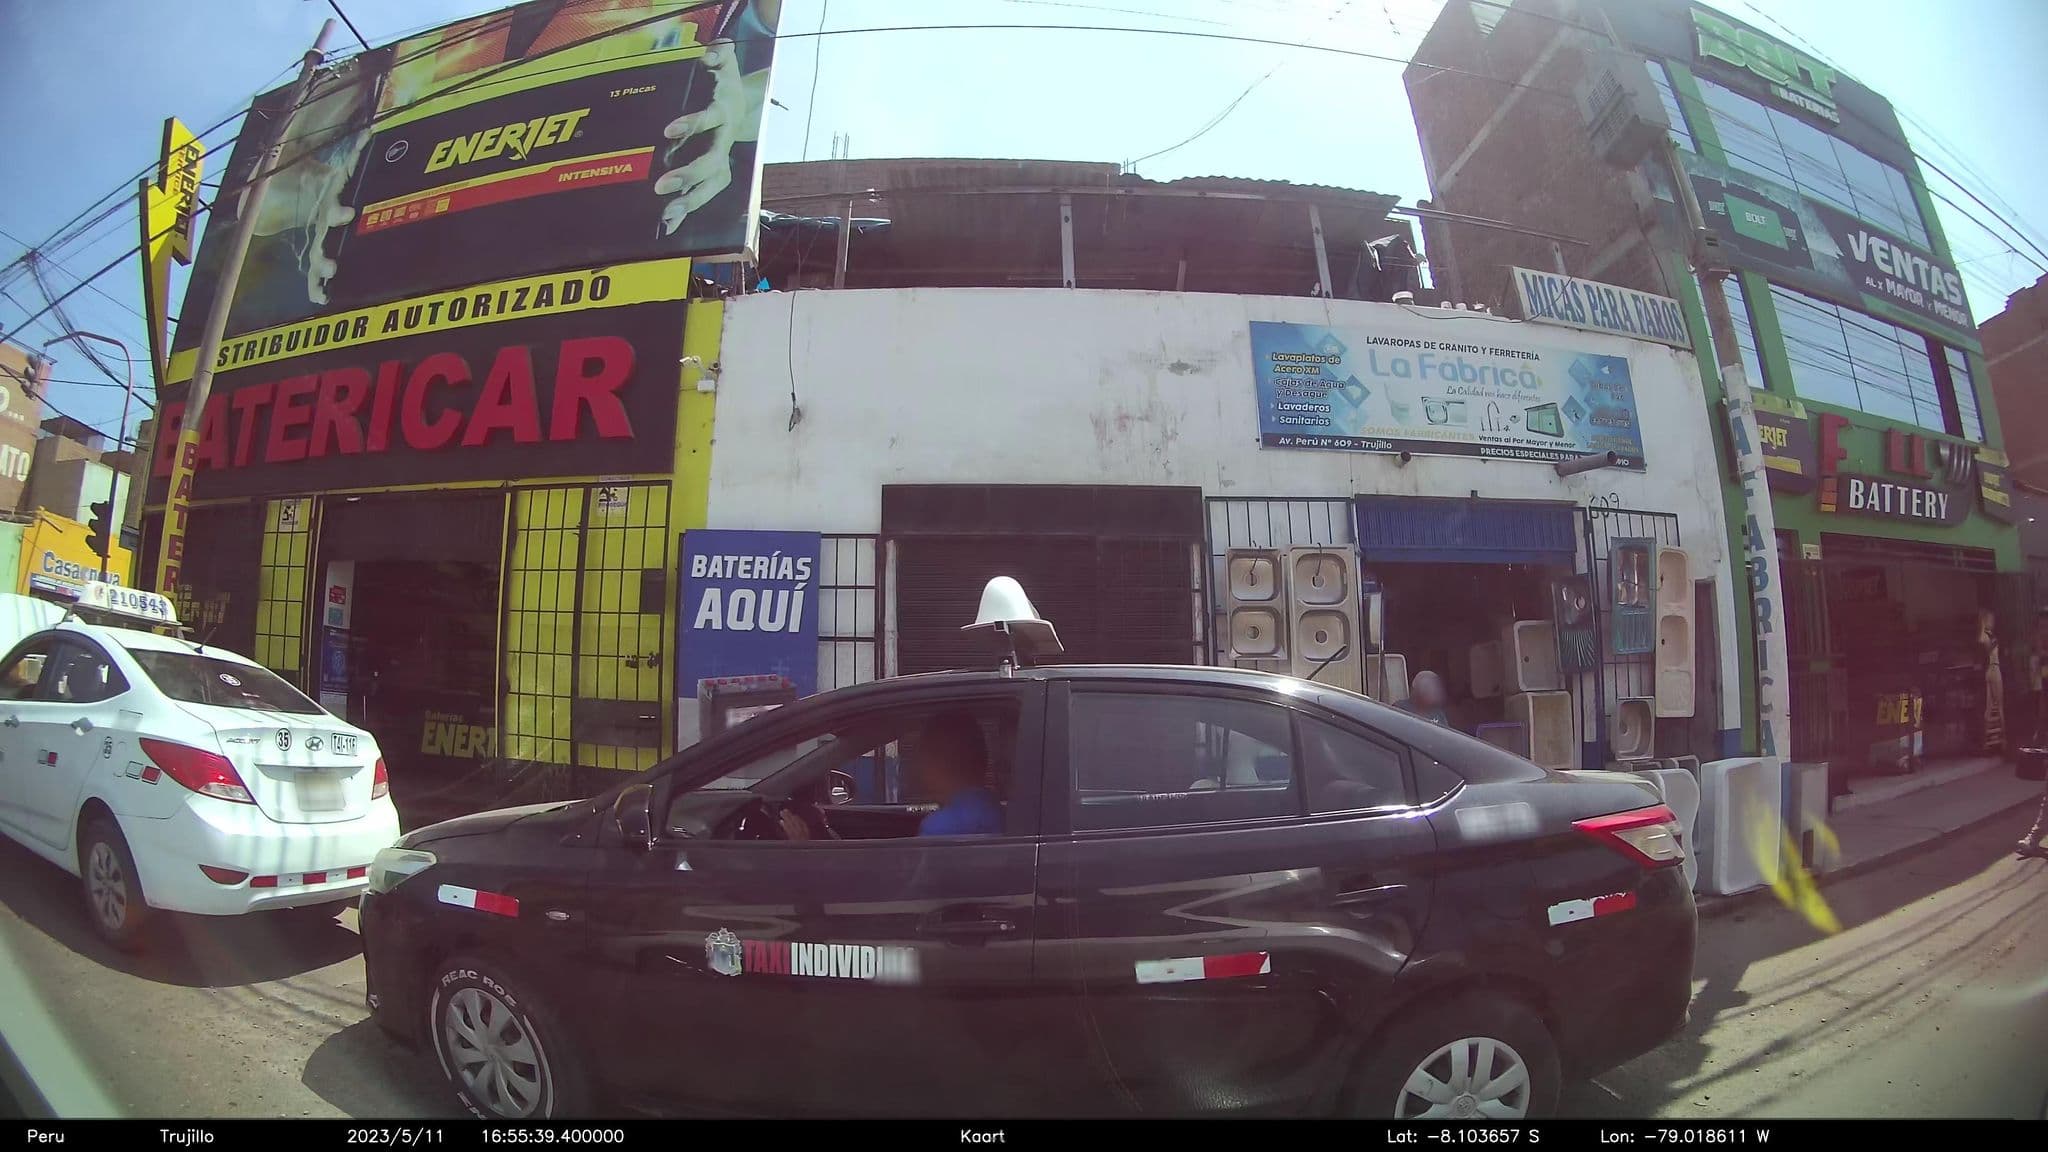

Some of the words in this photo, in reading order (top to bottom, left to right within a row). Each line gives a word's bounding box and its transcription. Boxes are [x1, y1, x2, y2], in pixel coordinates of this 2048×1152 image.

[622, 85, 657, 96] Placas
[424, 107, 591, 174] ENERJET
[558, 163, 632, 183] INTENSIVA
[1847, 230, 1963, 306] VENTAS
[382, 275, 611, 333] AUTORIZADO
[1885, 278, 1924, 308] MAYOR
[1521, 272, 1585, 324] MICAS
[1584, 284, 1638, 334] PARA
[1631, 294, 1686, 343] FAROS
[1272, 353, 1327, 364] Lavaplatos
[1328, 356, 1341, 364] de
[1366, 335, 1421, 349] LAVAROPAS
[1439, 342, 1478, 353] GRANITO
[1481, 346, 1487, 355] Y
[1489, 347, 1540, 361] FERRETERÍA
[1274, 365, 1304, 374] Acero
[1369, 348, 1412, 378] La
[1320, 381, 1345, 390] Agua
[1278, 402, 1330, 413] Lavaderos
[1280, 416, 1330, 426] Sanitarios
[1279, 437, 1293, 445] Av.
[1334, 438, 1352, 447] 609
[1361, 440, 1392, 450] Trujillo
[1479, 435, 1502, 443] Ventas
[1526, 438, 1548, 447] Mayor
[1555, 441, 1576, 449] Menor
[1480, 447, 1514, 455] PRECIOS
[1516, 449, 1559, 460] ESPECIALES
[1849, 478, 1948, 520] BATTERY
[42, 551, 80, 580] Casa
[691, 551, 812, 581] BATERÍAS
[693, 583, 808, 633] AQUÍ
[278, 732, 289, 748] 35
